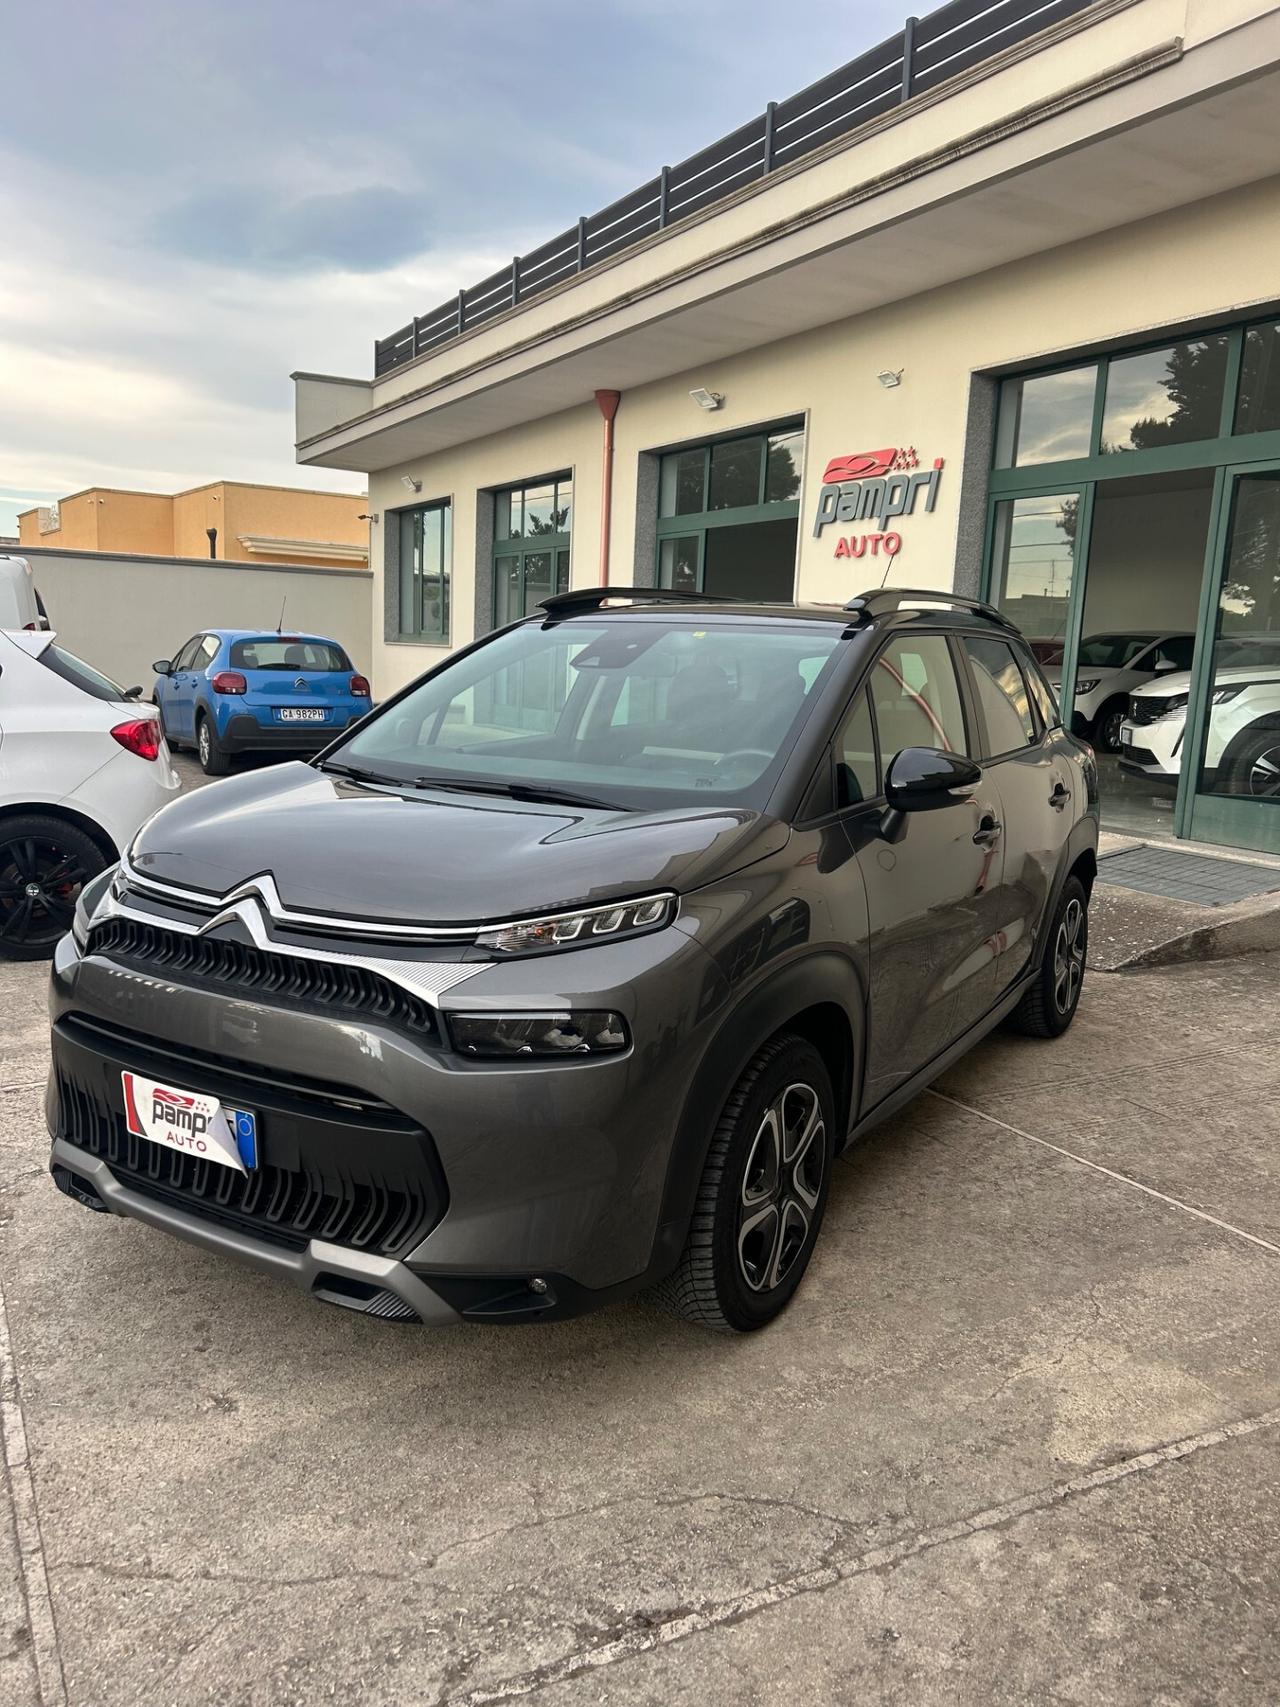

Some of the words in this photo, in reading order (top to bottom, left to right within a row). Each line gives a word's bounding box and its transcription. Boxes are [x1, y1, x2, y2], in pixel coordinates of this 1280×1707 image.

[813, 457, 943, 538] pampri
[834, 531, 902, 560] AUTO
[152, 1099, 212, 1138] pamp
[166, 1131, 207, 1152] AUTO
